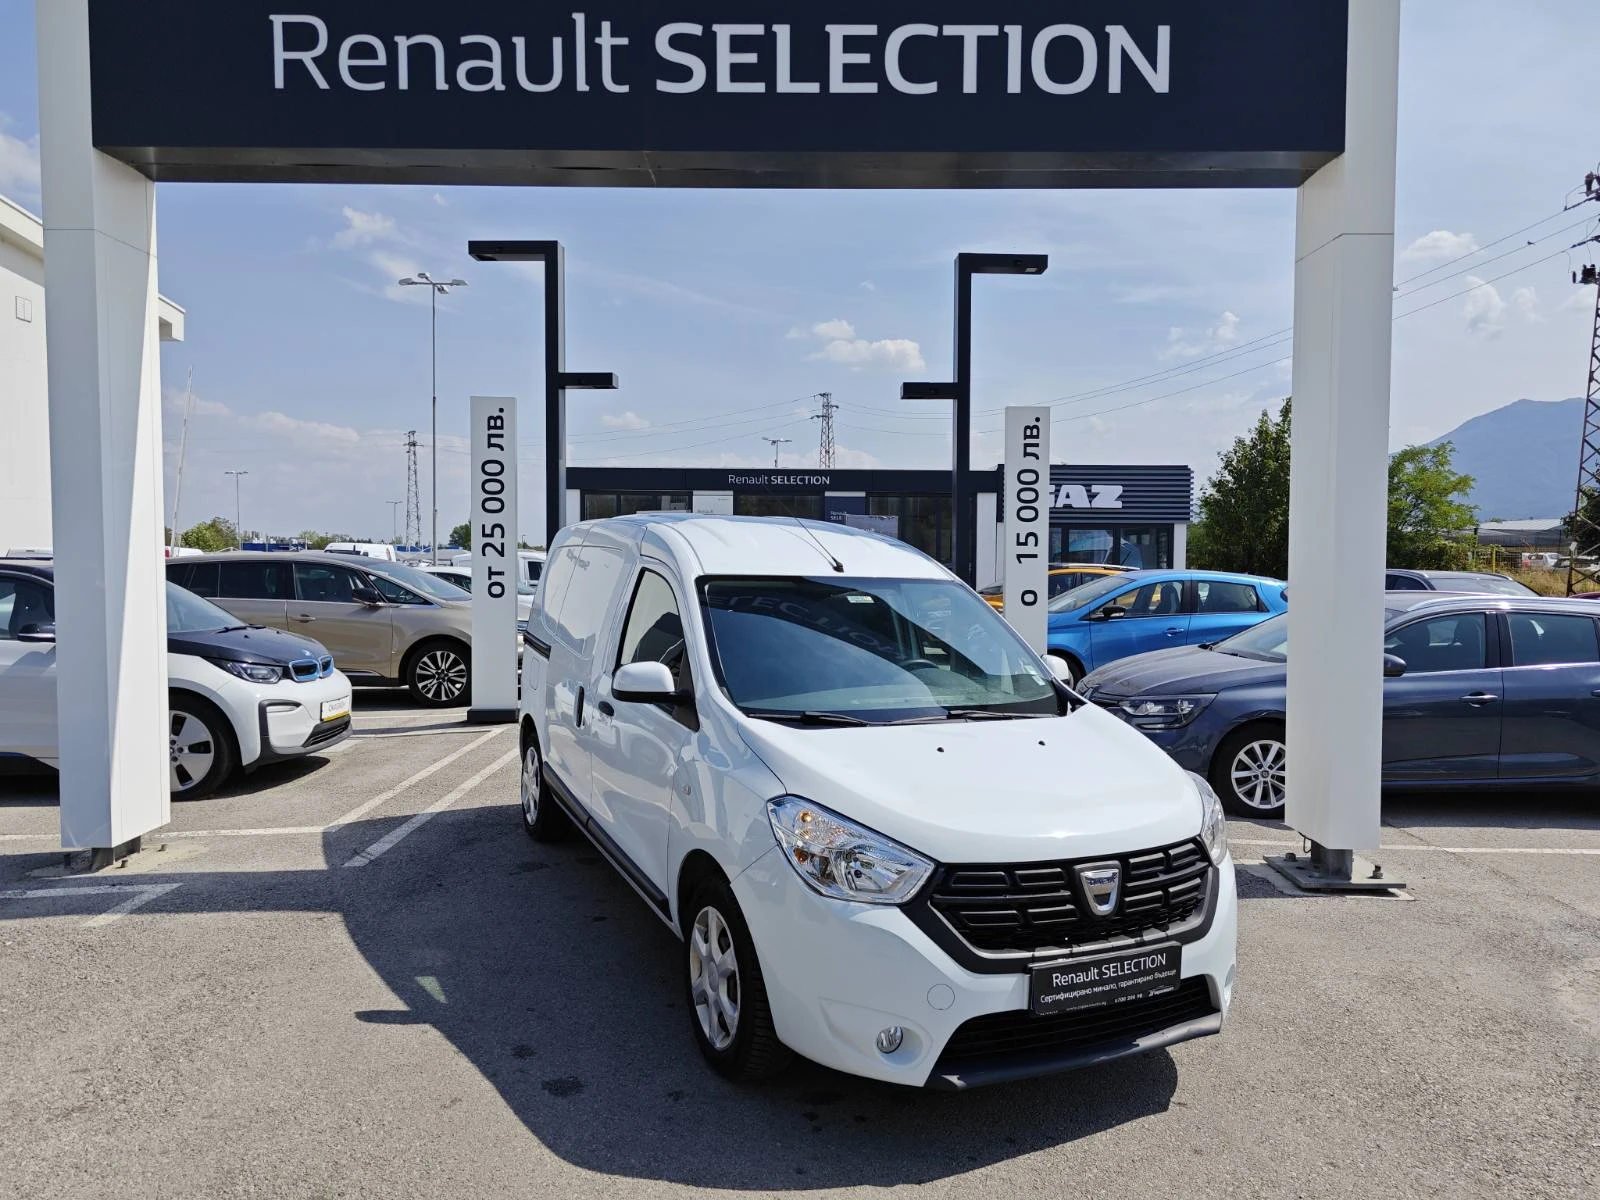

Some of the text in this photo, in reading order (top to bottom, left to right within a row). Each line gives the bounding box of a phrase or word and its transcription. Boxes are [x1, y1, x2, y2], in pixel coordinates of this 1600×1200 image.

[268, 12, 1171, 95] Renault SELECTION
[1023, 416, 1041, 461] лв.
[728, 474, 830, 485] Renault SELECTION
[1016, 468, 1040, 523] 000
[1049, 484, 1123, 509] AZ
[480, 407, 506, 599] от 25 000 лв.
[1016, 531, 1039, 565] 15
[1052, 952, 1167, 988] Renault SELECTION
[1040, 988, 1092, 1003] Сертифицирано
